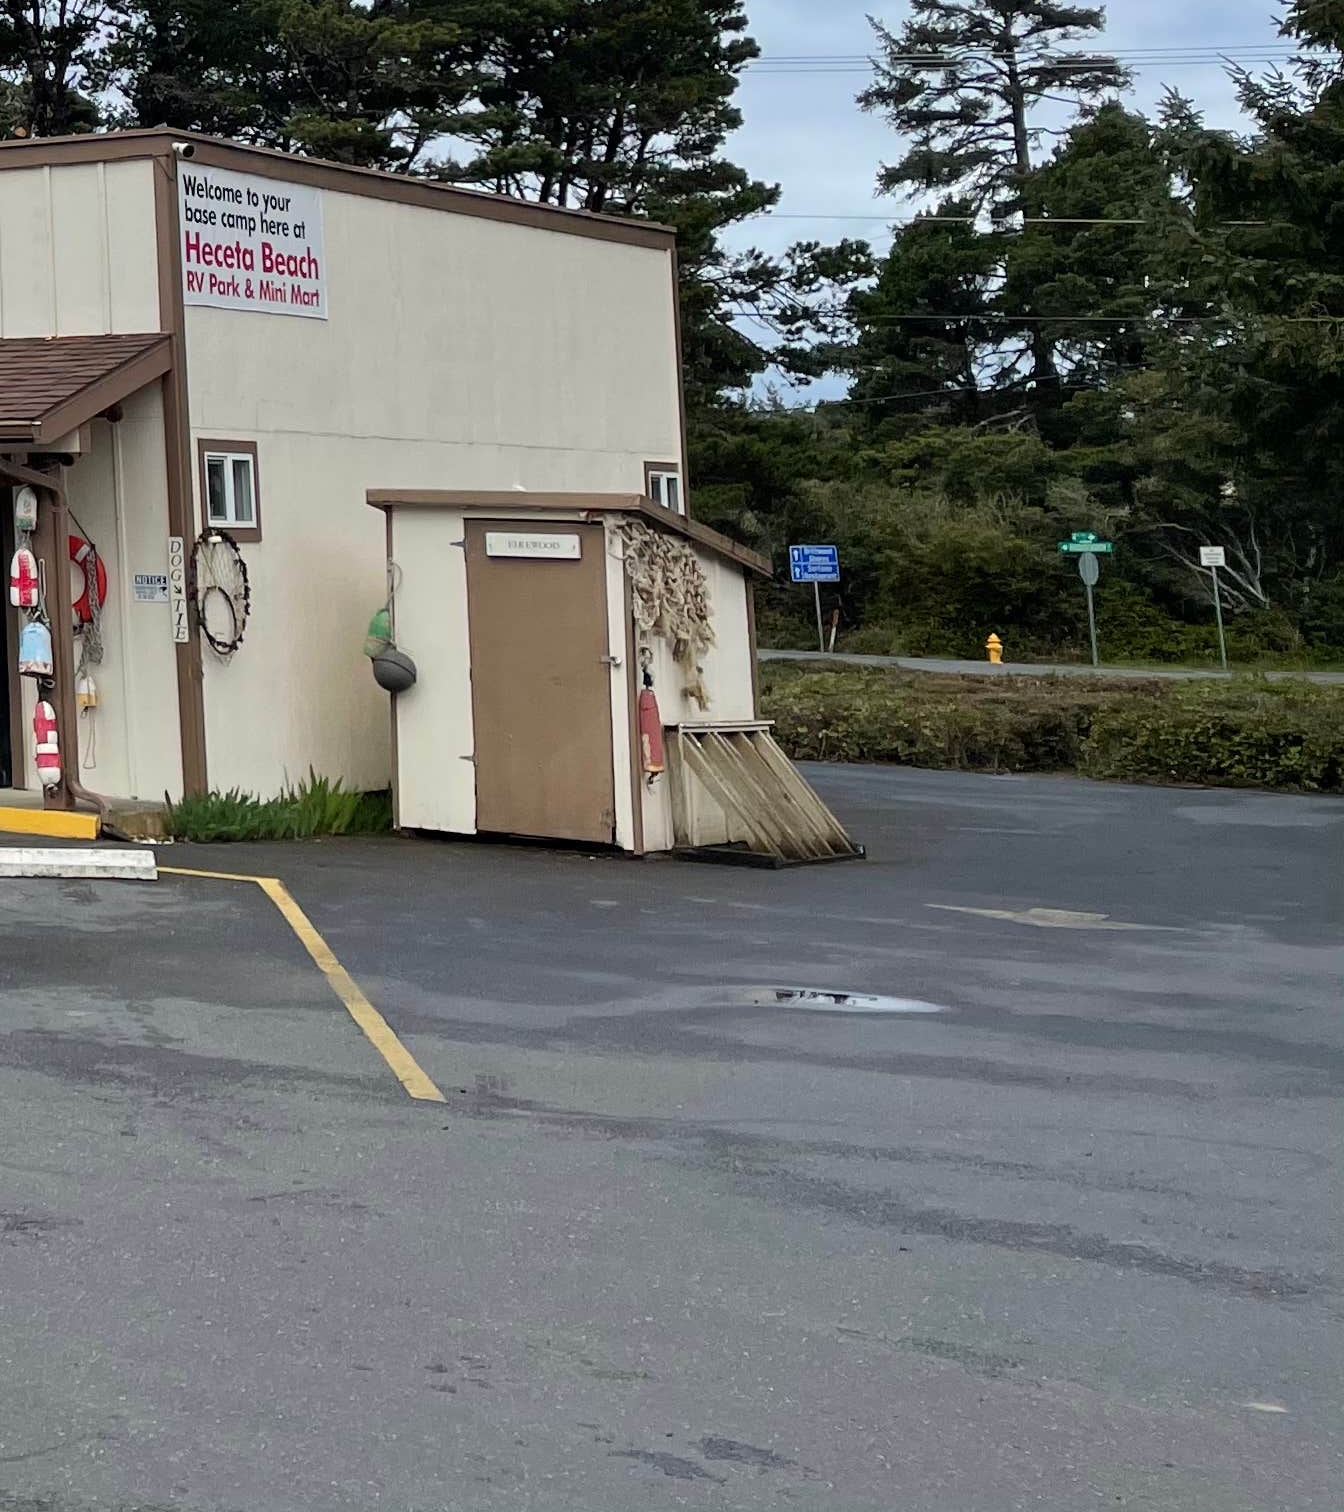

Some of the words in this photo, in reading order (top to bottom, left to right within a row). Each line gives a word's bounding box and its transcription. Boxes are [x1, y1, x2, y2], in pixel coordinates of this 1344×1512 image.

[183, 174, 242, 205] Welcome
[246, 188, 259, 207] to
[263, 194, 291, 214] your
[184, 199, 217, 226] base
[221, 210, 256, 237] camp
[260, 212, 289, 237] here
[293, 222, 305, 239] at
[185, 230, 254, 271] Heceta
[261, 242, 319, 280] Beach
[186, 270, 204, 293] RV
[209, 273, 240, 298] Park
[244, 278, 255, 299] &
[259, 280, 287, 303] Mini
[291, 283, 320, 307] Mart
[135, 575, 167, 585] NOTICE
[170, 540, 183, 582] DOG
[173, 598, 186, 640] TIE
